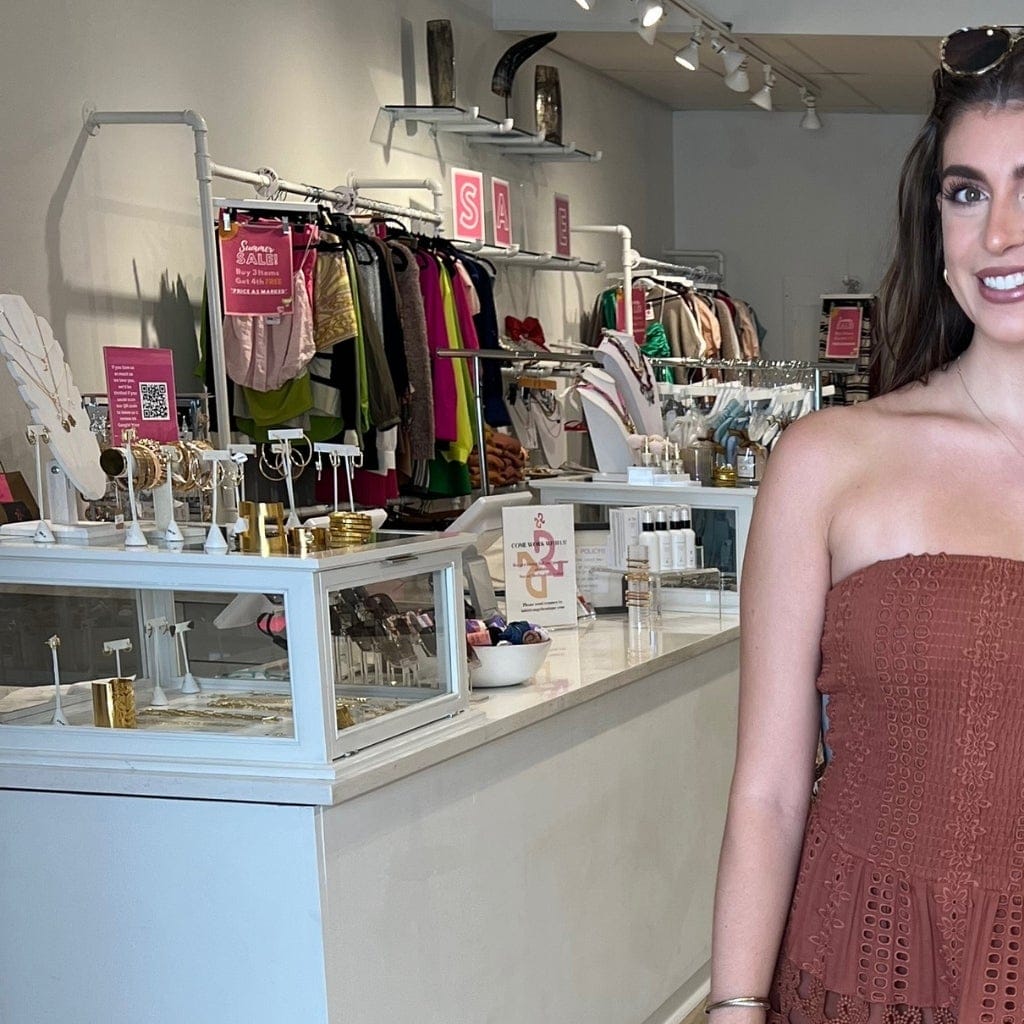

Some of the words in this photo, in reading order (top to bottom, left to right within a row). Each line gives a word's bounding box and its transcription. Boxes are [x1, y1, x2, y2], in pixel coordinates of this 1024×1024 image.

[460, 182, 479, 230] S
[497, 193, 509, 231] A
[239, 240, 274, 253] Summer
[236, 253, 278, 265] SALE!
[236, 268, 251, 277] Buy
